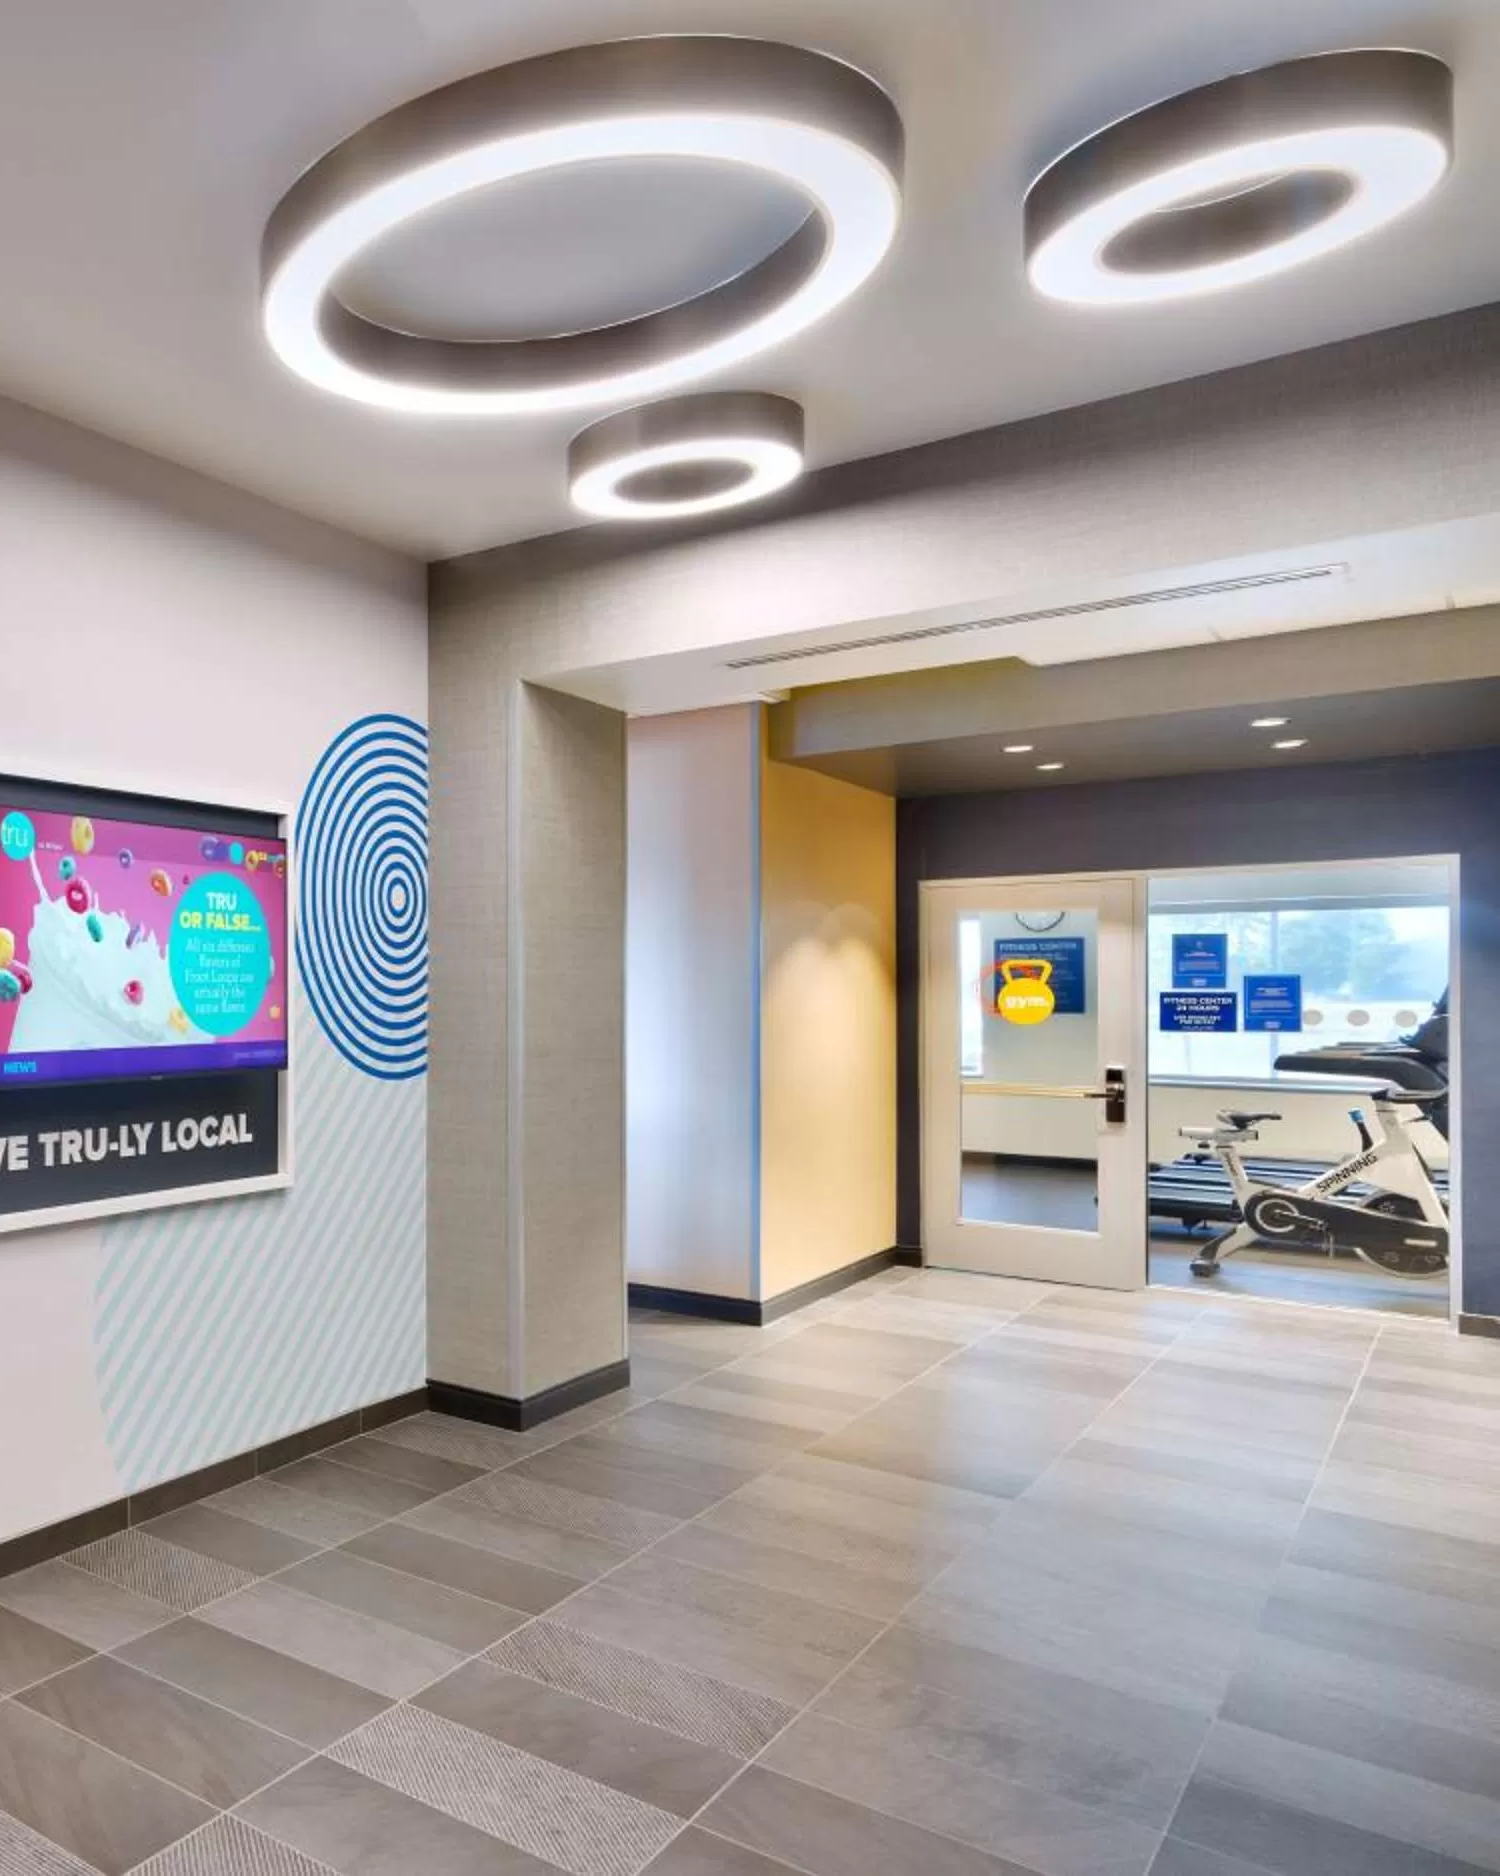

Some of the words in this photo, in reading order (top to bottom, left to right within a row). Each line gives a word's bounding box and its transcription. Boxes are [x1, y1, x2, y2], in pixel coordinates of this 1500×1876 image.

[1, 820, 29, 847] tru
[205, 891, 237, 911] TRU
[179, 911, 203, 929] OR
[1004, 995, 1050, 1009] gym.
[1163, 997, 1198, 1005] FITNESS
[1199, 997, 1233, 1005] CENTER
[3, 1061, 37, 1074] NEWS
[37, 1121, 153, 1168] TRU-LY
[160, 1113, 253, 1153] LOCAL
[1317, 1152, 1378, 1193] SPINNING
